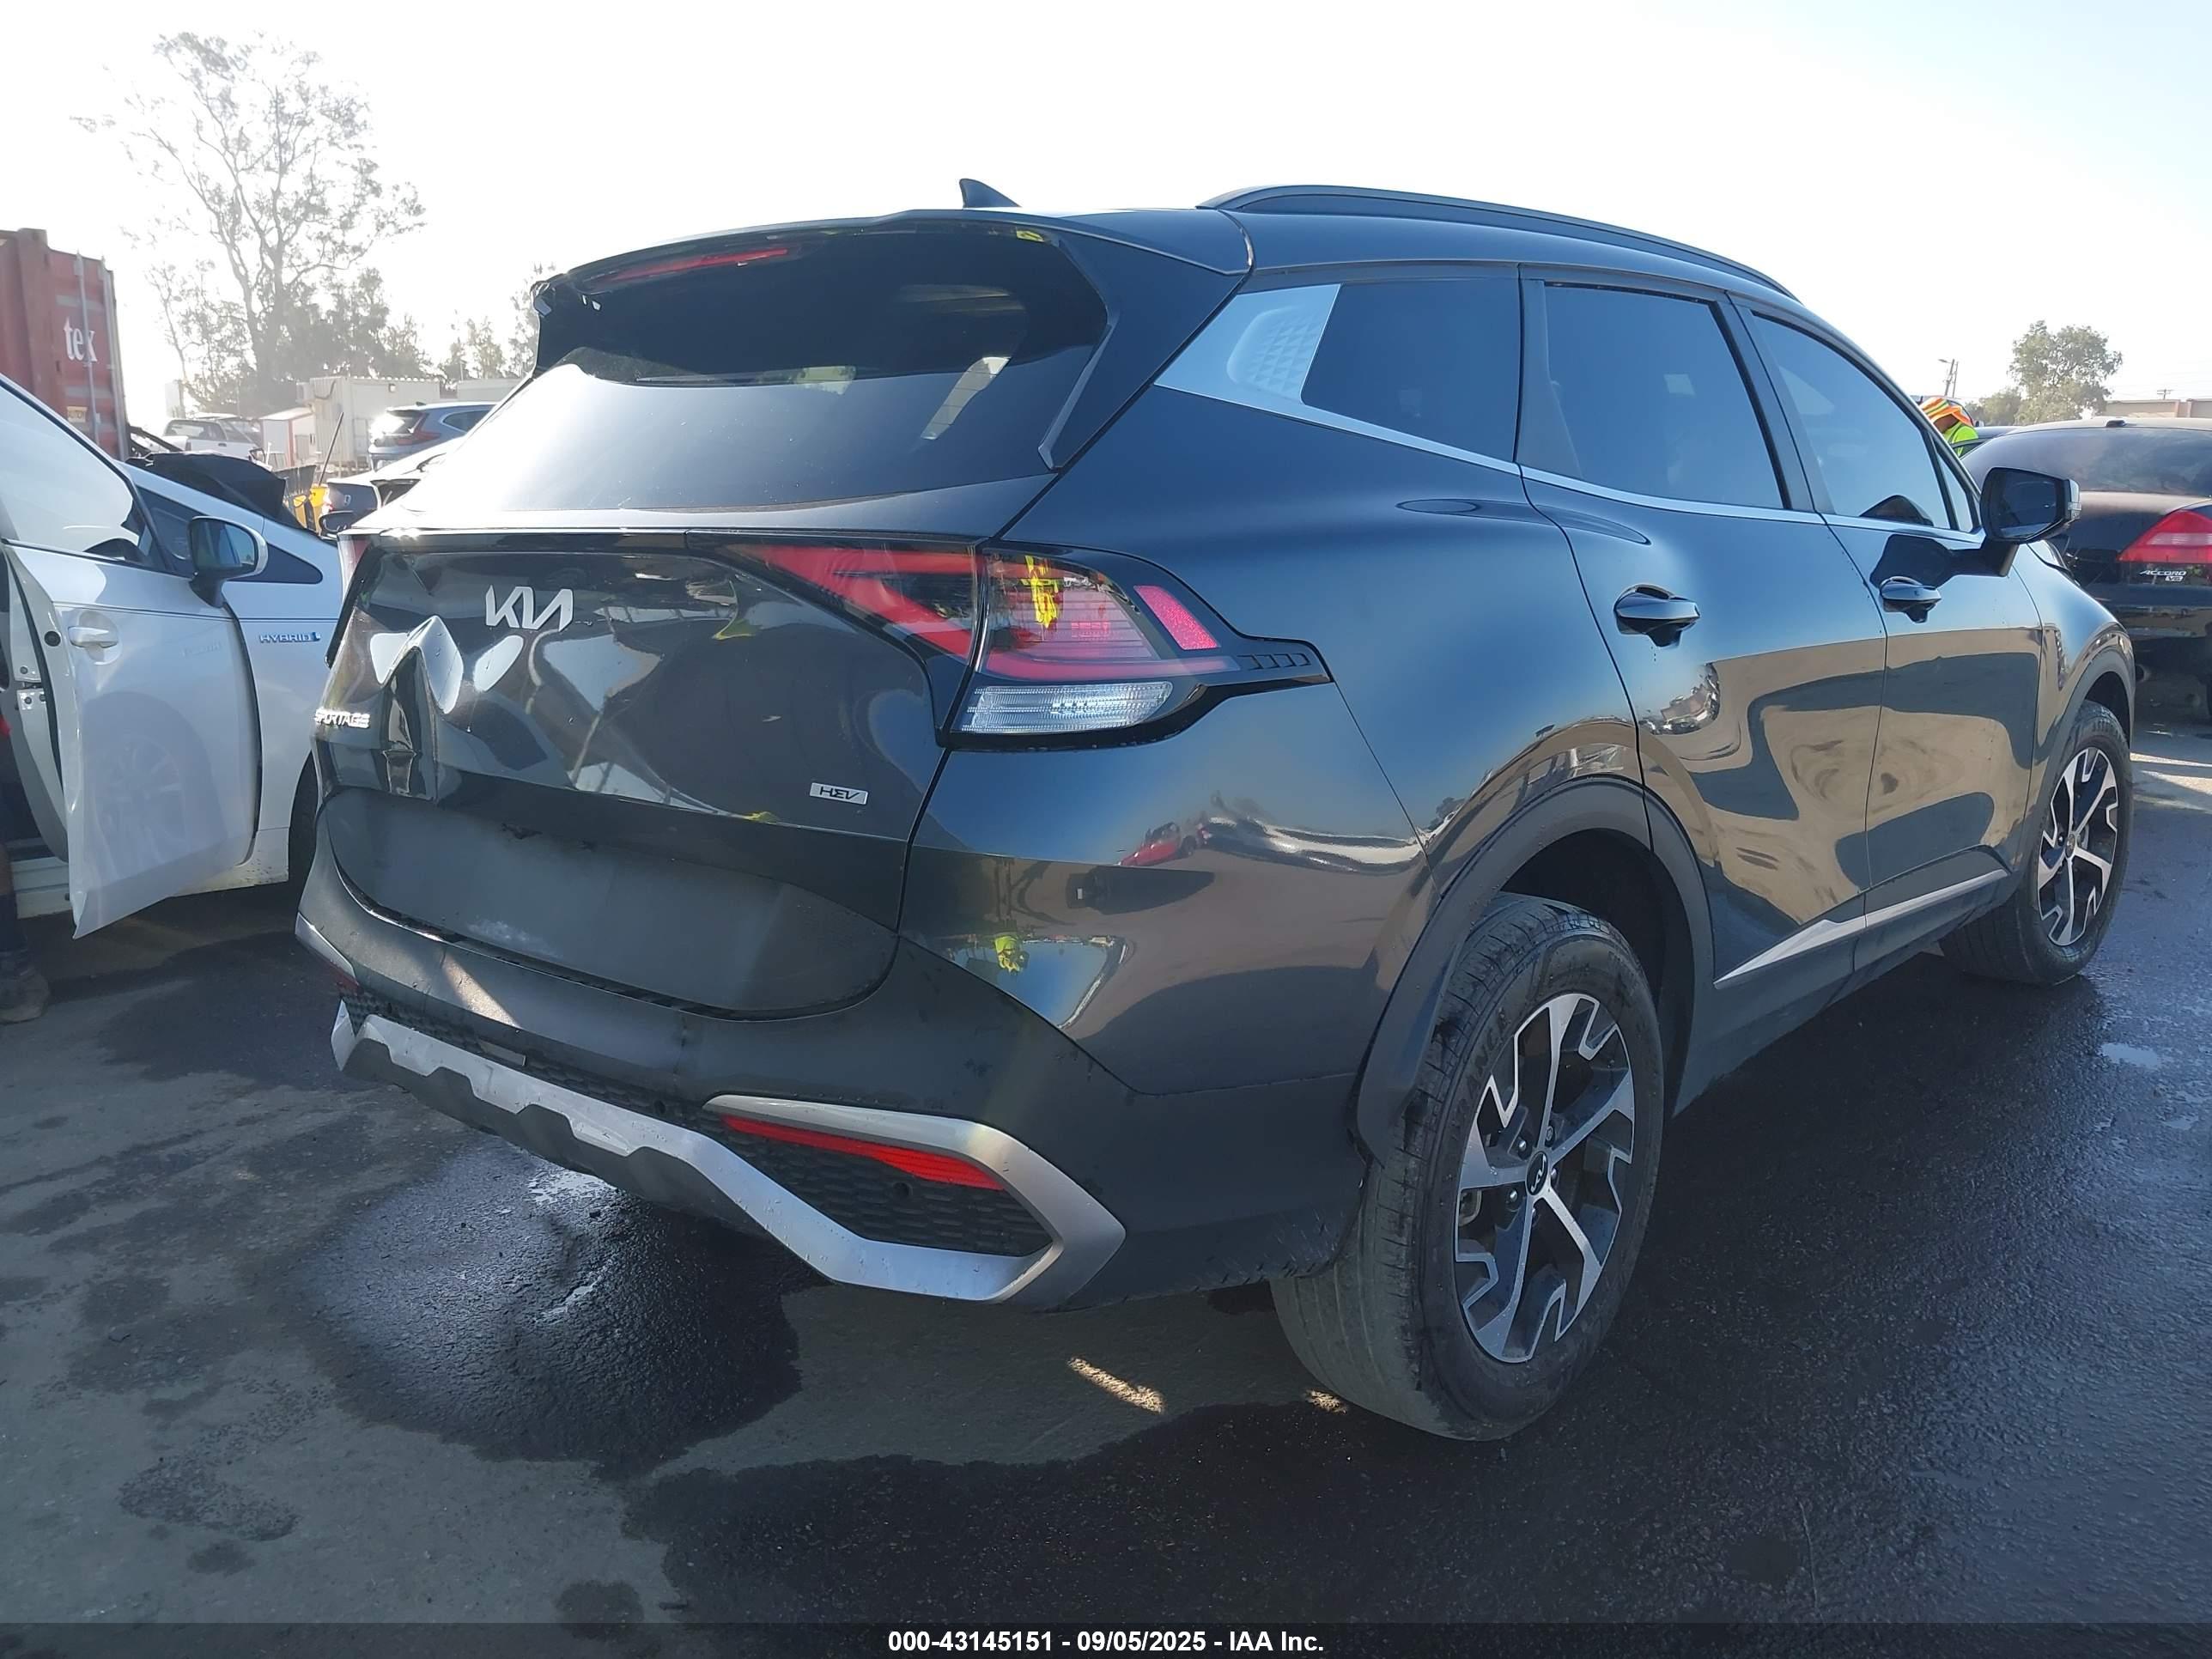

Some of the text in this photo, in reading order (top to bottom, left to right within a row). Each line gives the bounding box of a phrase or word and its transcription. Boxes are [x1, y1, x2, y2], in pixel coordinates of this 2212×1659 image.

[486, 585, 574, 631] KIA
[259, 634, 313, 643] HYBRID
[819, 786, 860, 799] HEV
